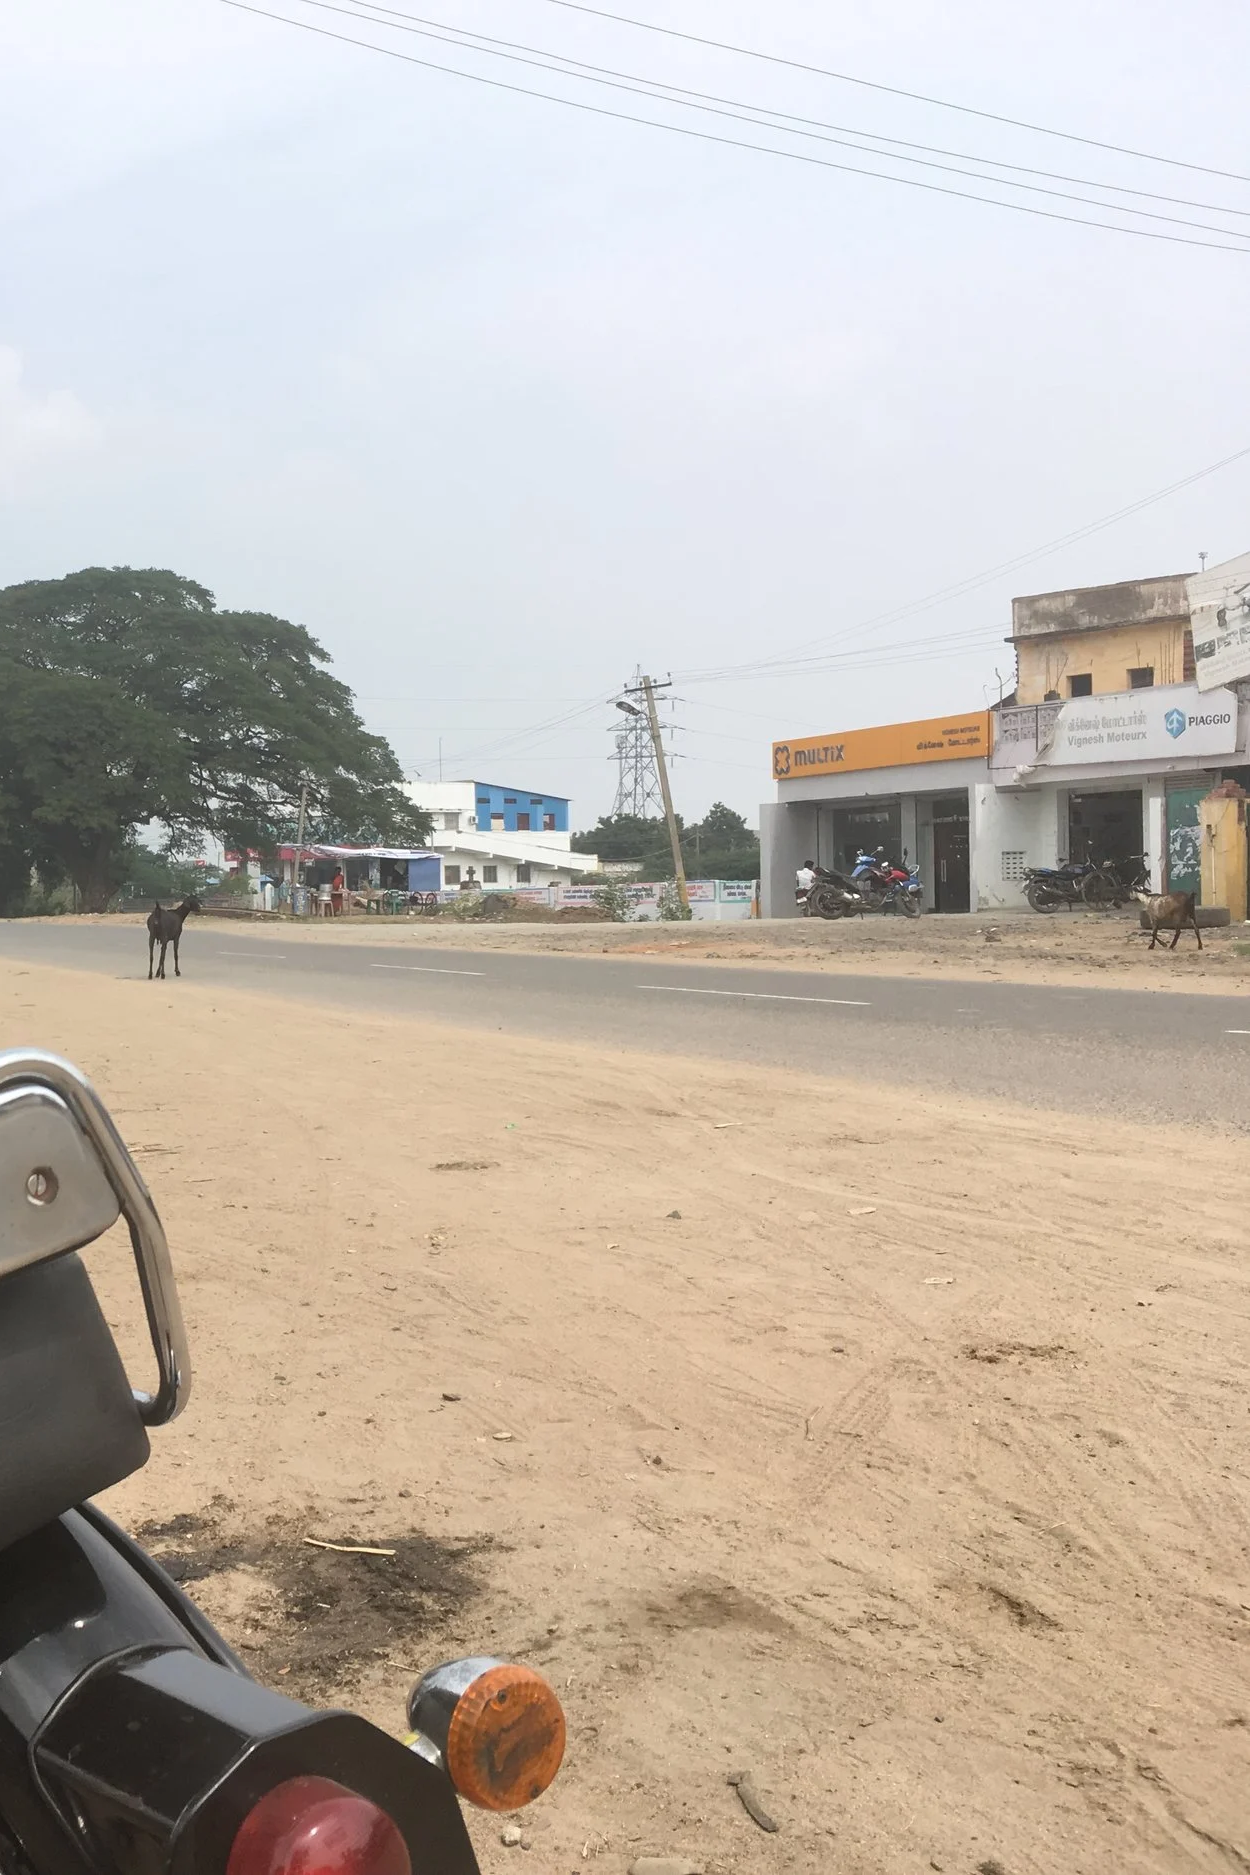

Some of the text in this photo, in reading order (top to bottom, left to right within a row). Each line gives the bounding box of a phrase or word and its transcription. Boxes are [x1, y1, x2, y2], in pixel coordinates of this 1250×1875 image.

[1188, 713, 1231, 727] PIAGGIO
[1068, 731, 1147, 747] Vignesh Moteurx
